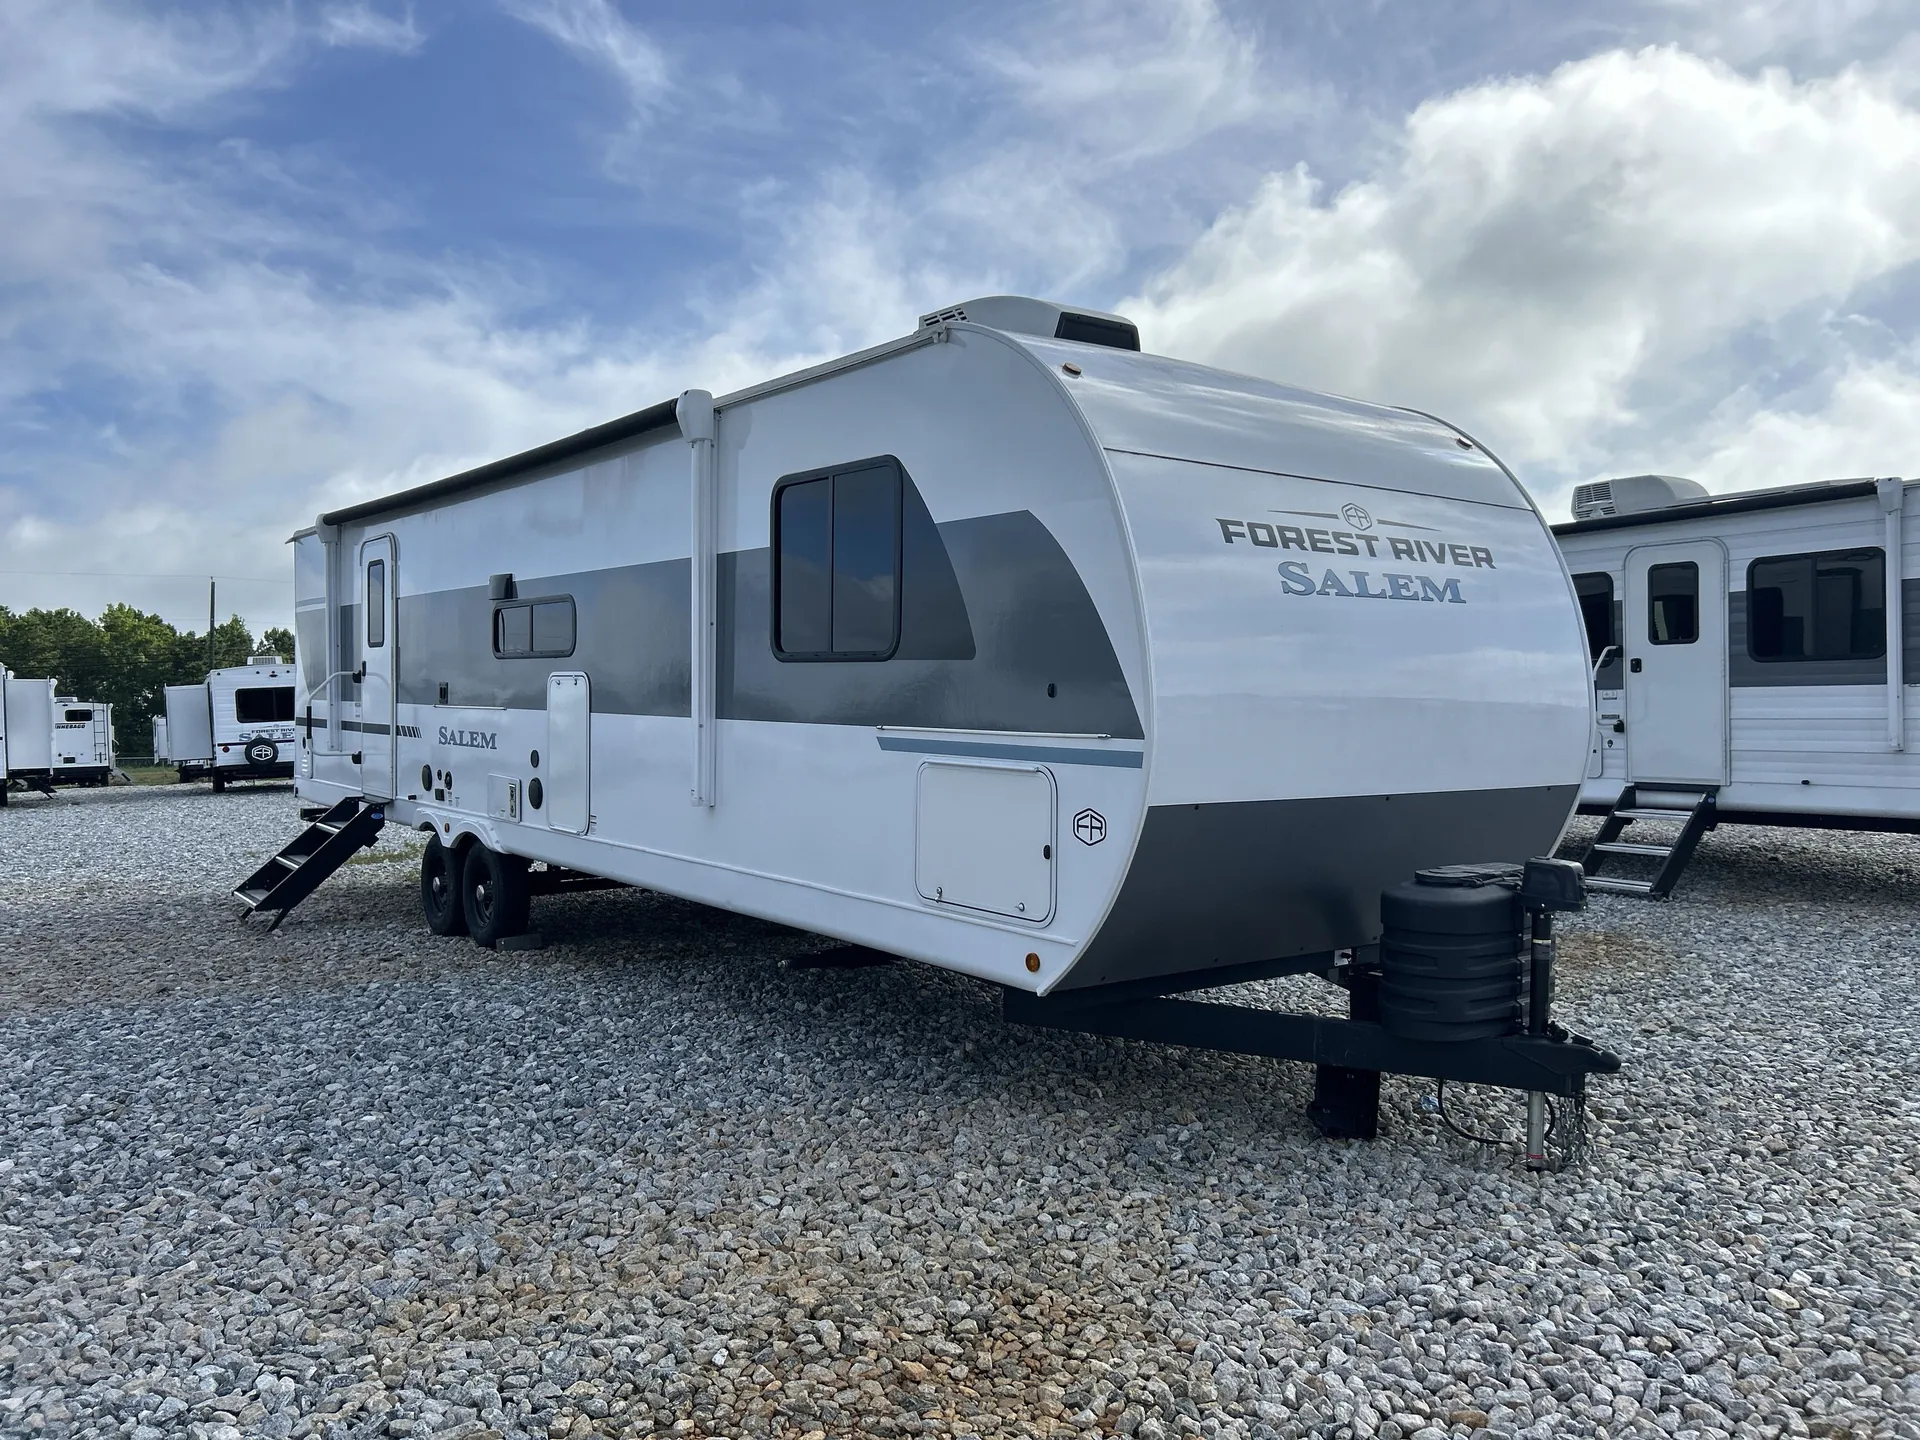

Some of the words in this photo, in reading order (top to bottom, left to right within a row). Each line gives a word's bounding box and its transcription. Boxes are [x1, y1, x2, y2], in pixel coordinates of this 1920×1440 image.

[1215, 518, 1379, 557] FOREST
[1386, 537, 1497, 569] RIVER
[1278, 561, 1467, 604] SALEM
[439, 726, 498, 750] SALEM
